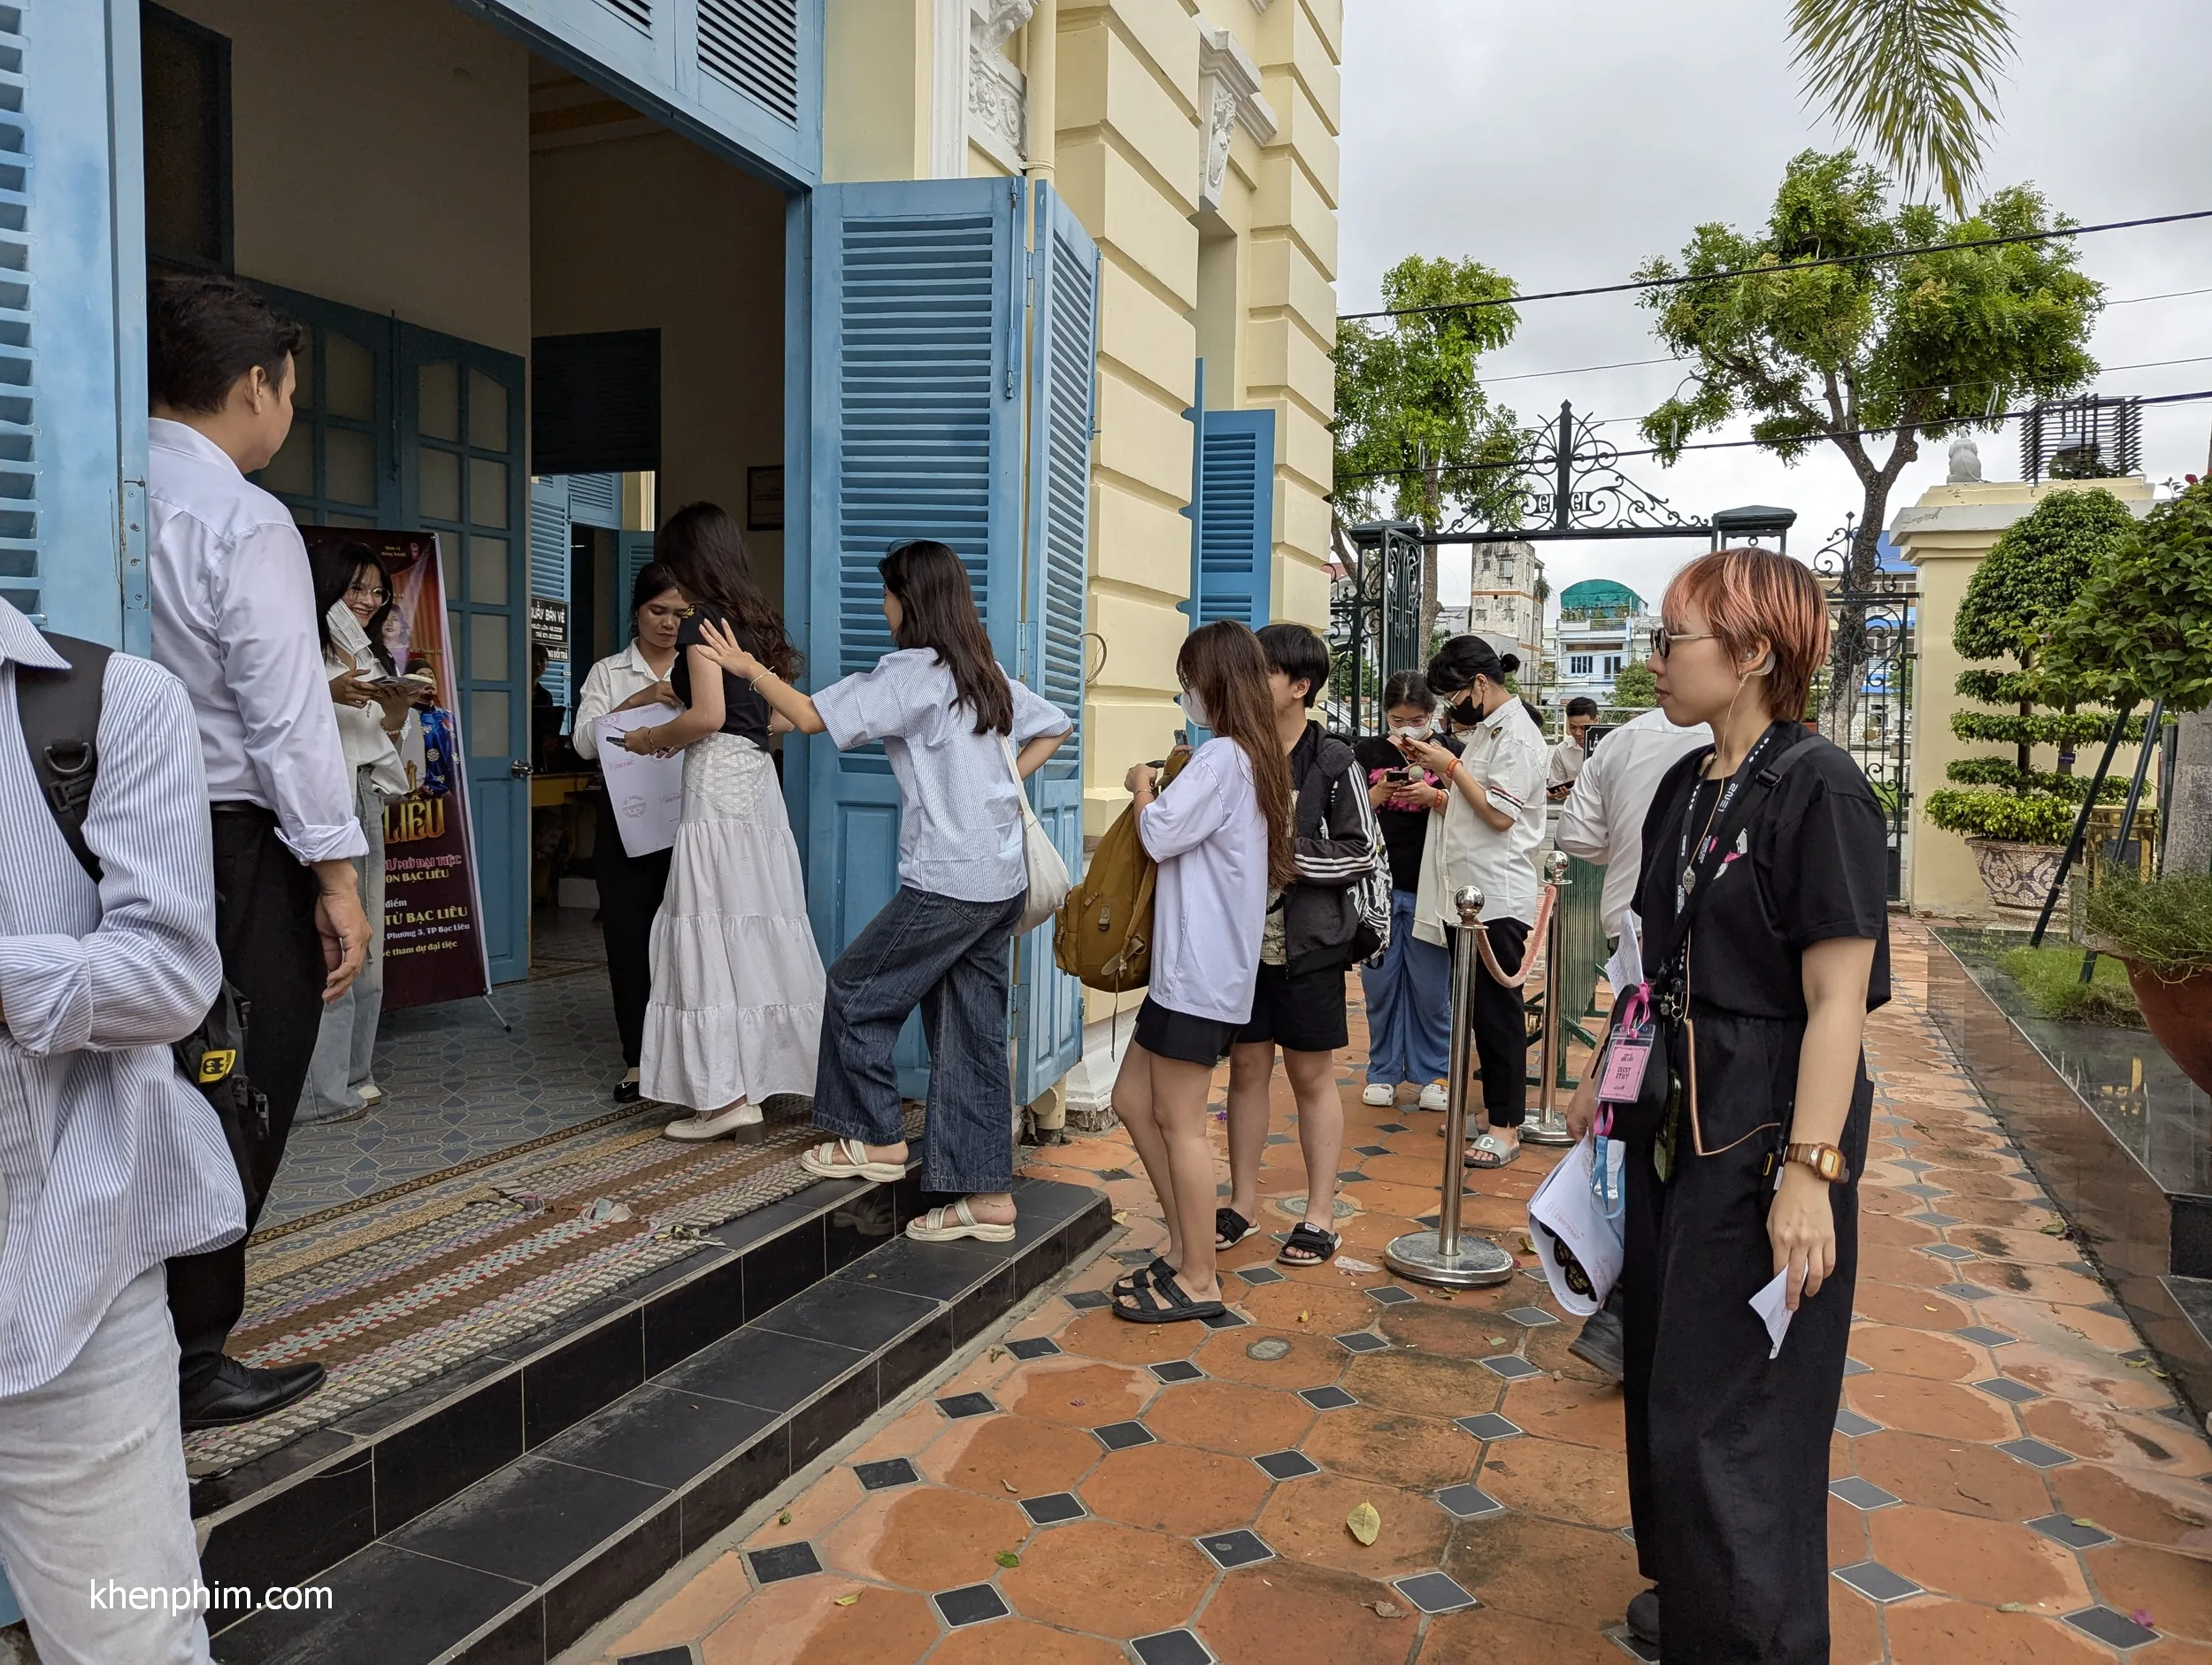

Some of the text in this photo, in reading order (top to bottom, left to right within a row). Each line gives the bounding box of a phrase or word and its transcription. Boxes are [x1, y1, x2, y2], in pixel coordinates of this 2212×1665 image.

[545, 606, 557, 623] BÁN
[557, 608, 565, 624] VÉ
[402, 871, 425, 883] BẠC
[405, 911, 434, 925] BẠC
[436, 905, 468, 919] LIÊU
[438, 925, 453, 933] Bạc
